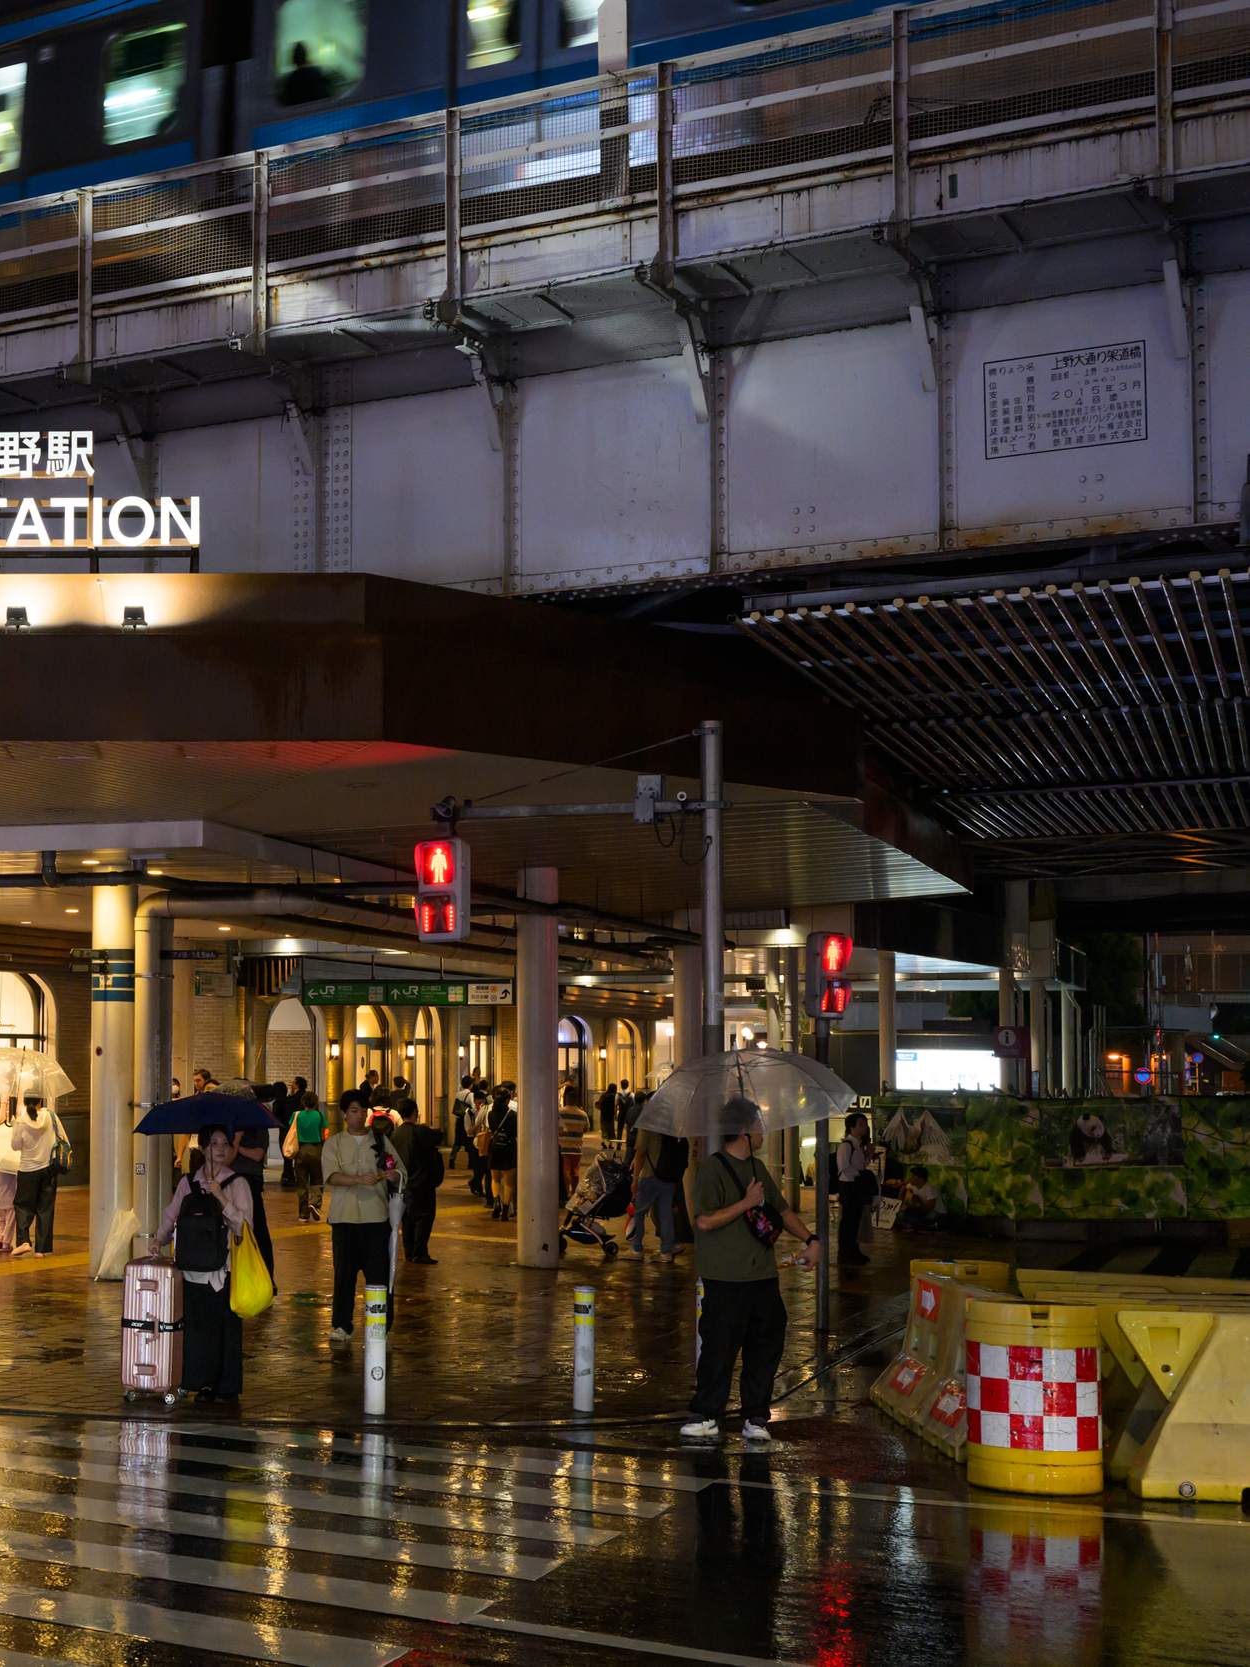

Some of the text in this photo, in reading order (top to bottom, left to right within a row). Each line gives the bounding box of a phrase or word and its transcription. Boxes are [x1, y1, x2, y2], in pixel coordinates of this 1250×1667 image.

[1051, 345, 1141, 370] 上野大通り架道橋
[319, 985, 335, 995] JR
[402, 985, 419, 995] JR
